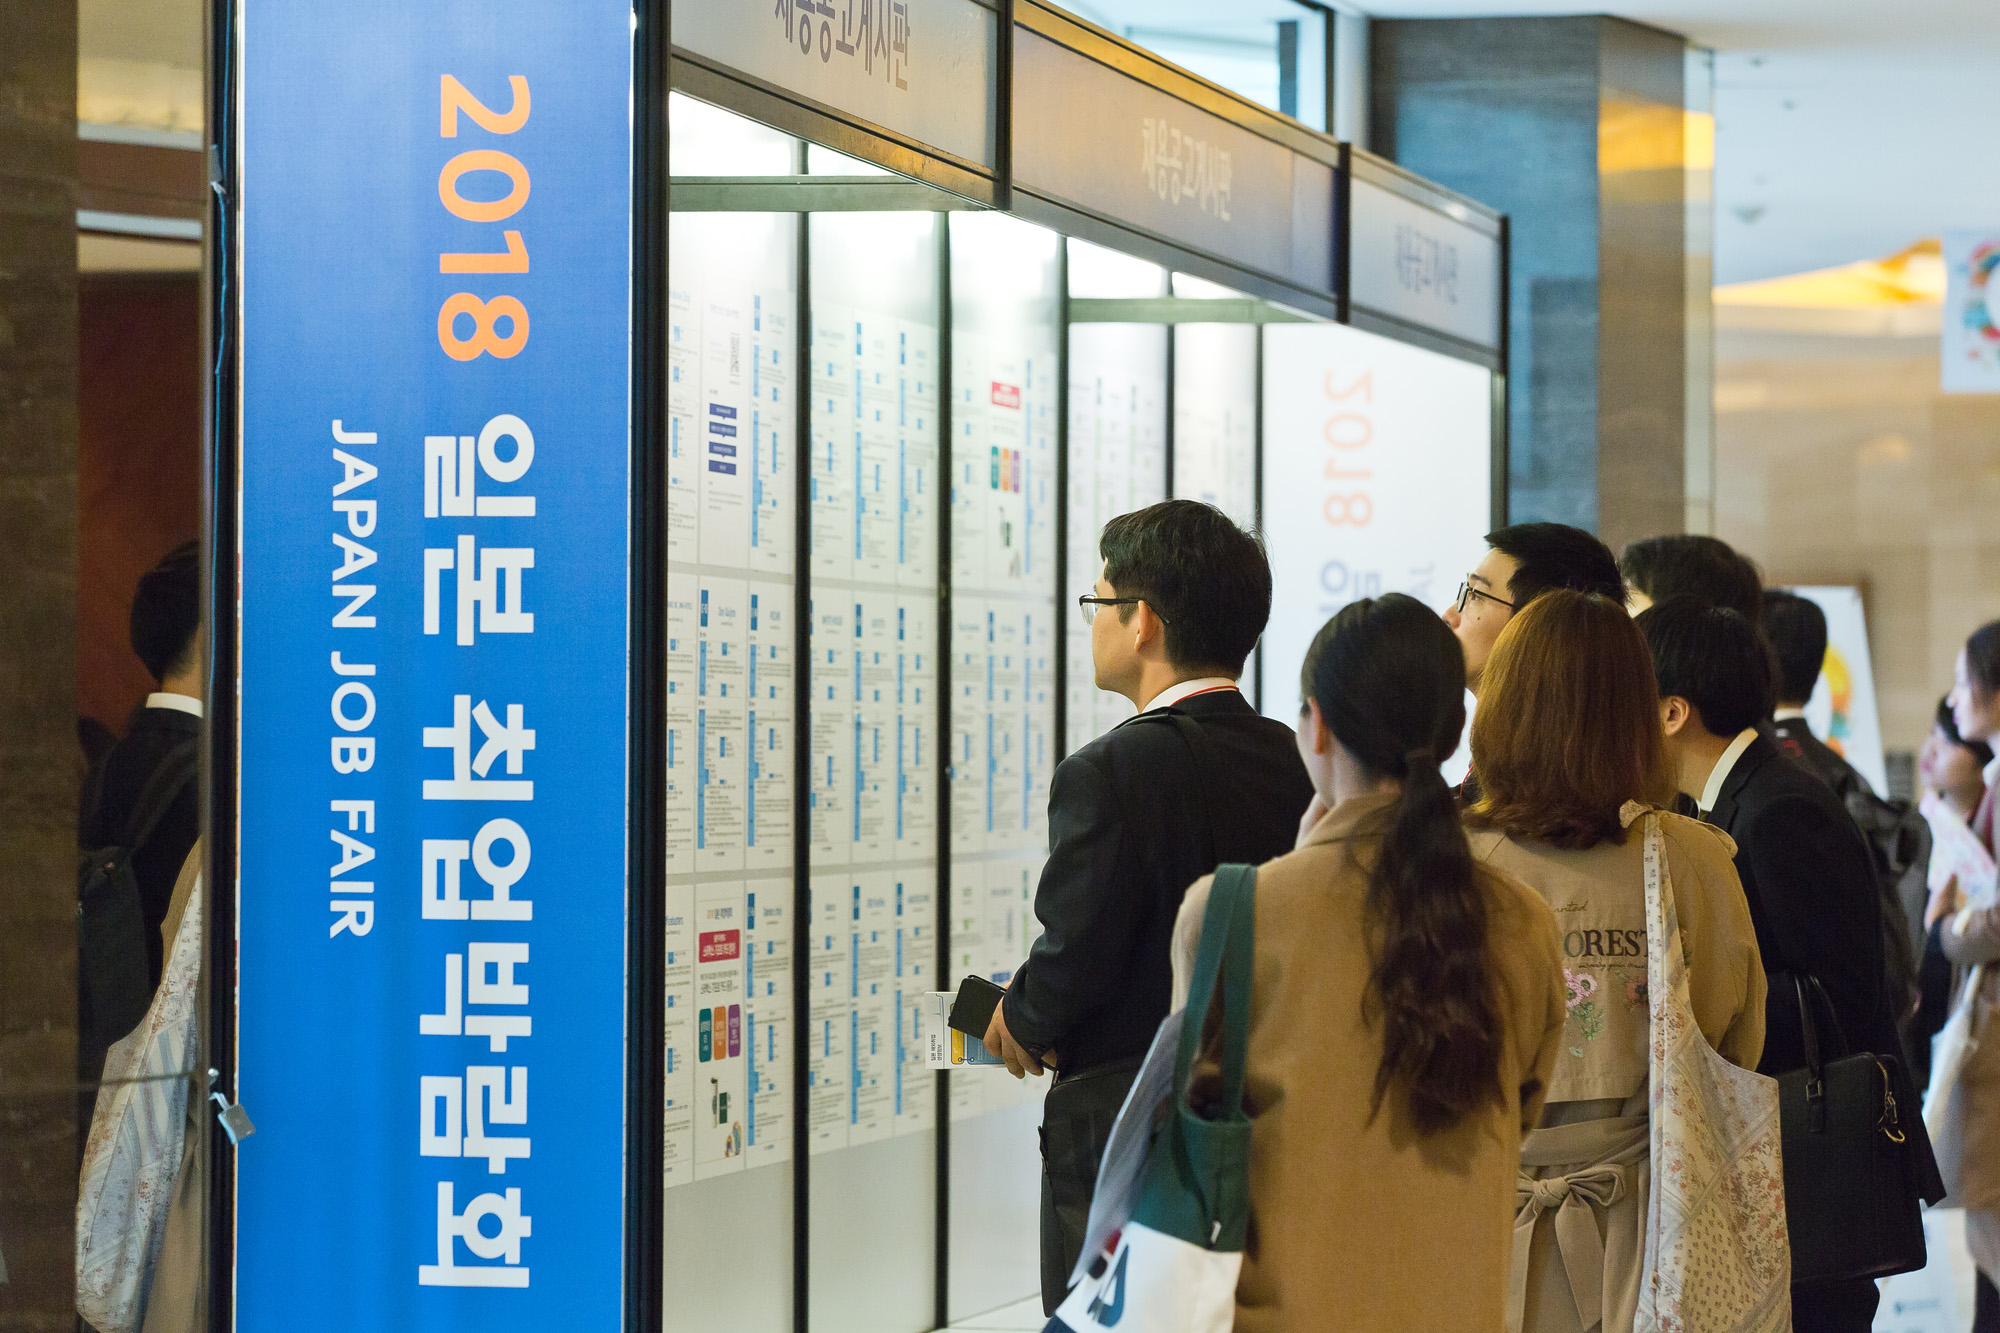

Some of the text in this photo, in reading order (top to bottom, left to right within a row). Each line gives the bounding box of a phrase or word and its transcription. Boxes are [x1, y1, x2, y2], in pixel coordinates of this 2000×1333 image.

[329, 419, 378, 939] JAPAN JOB FAIR
[418, 73, 536, 1288] 2018 일본 취업박람회
[1563, 929, 1649, 958] ORES
